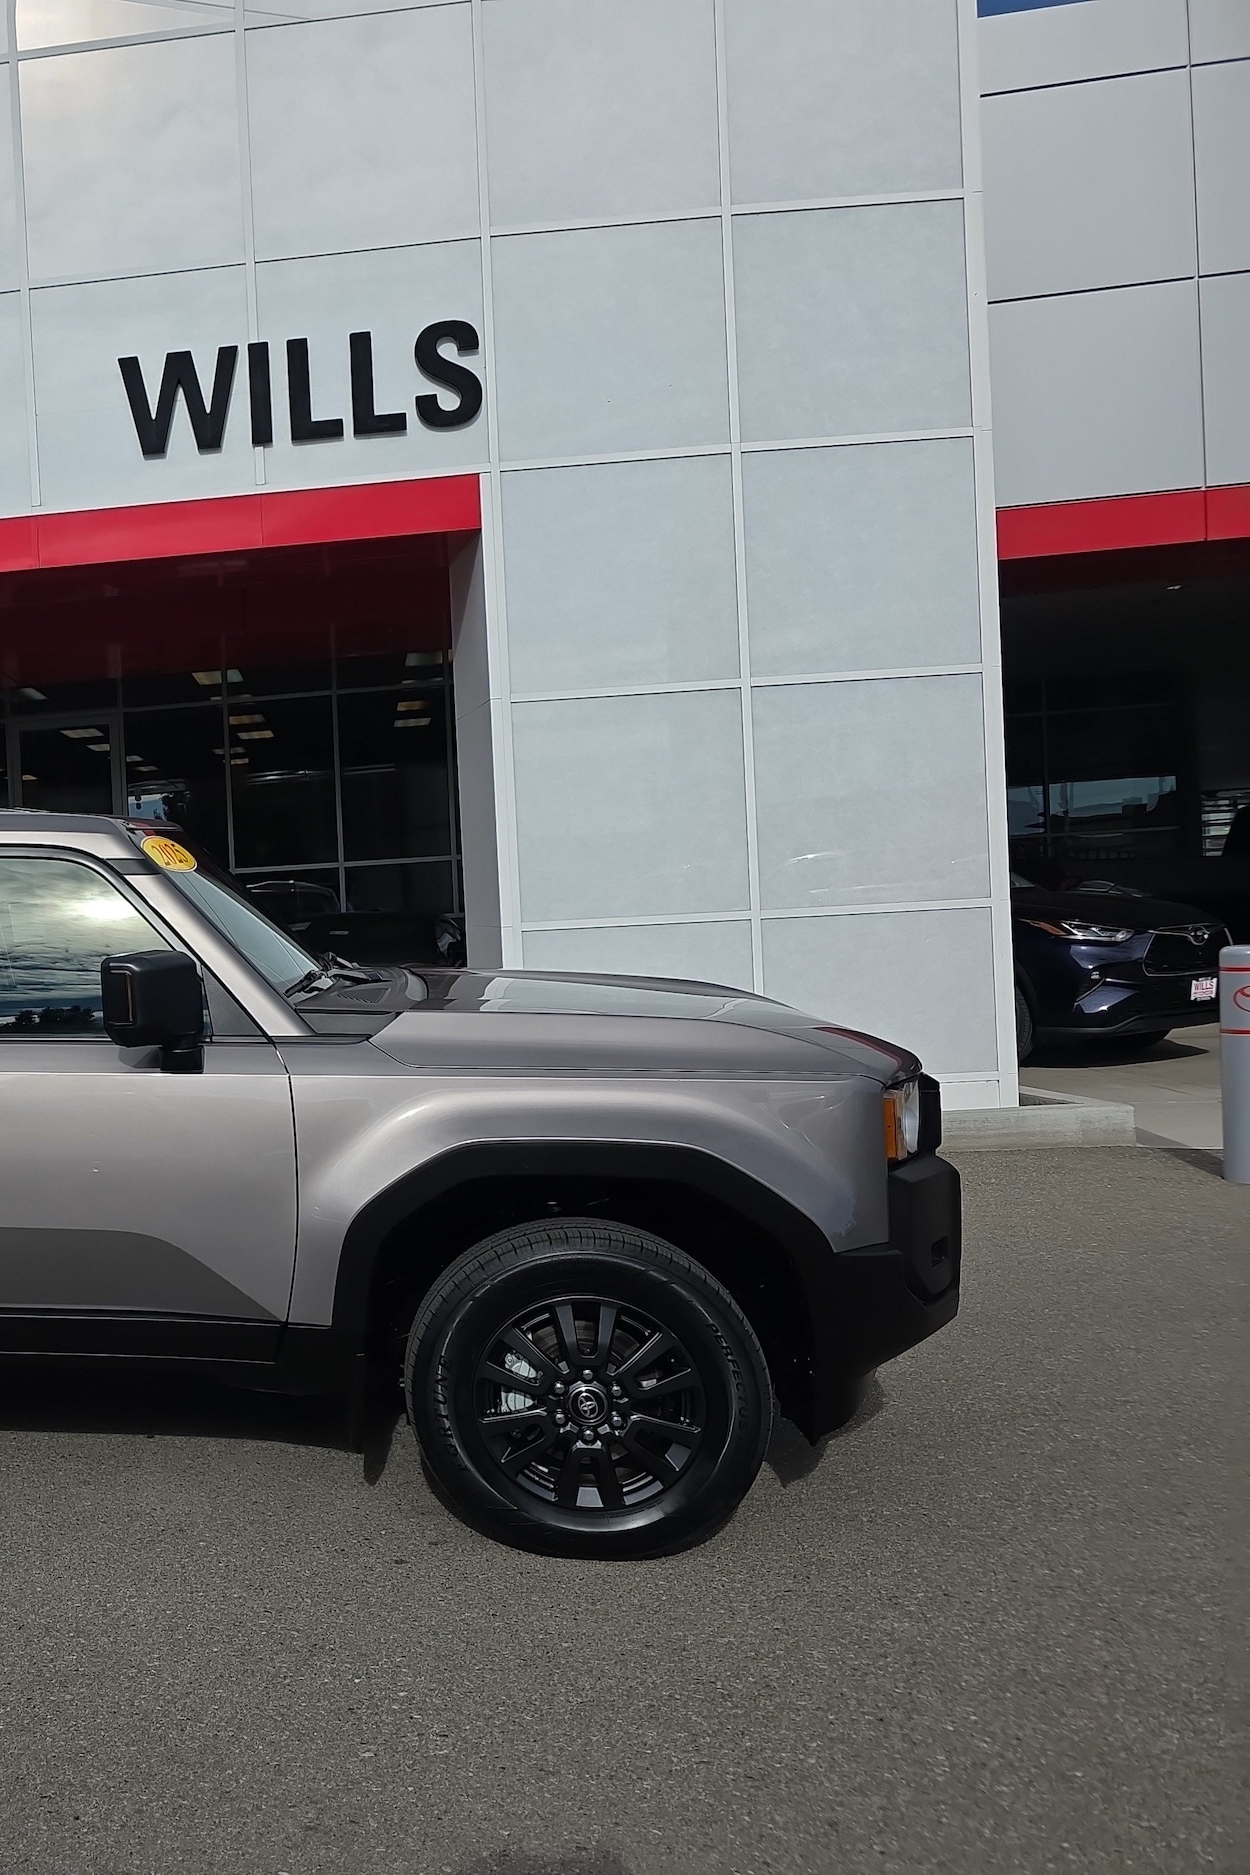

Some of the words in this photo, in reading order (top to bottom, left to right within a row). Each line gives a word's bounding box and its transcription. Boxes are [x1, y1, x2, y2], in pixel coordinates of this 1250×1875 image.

[117, 319, 483, 460] WILLS
[151, 843, 189, 866] 2025
[1193, 980, 1214, 991] WILLS
